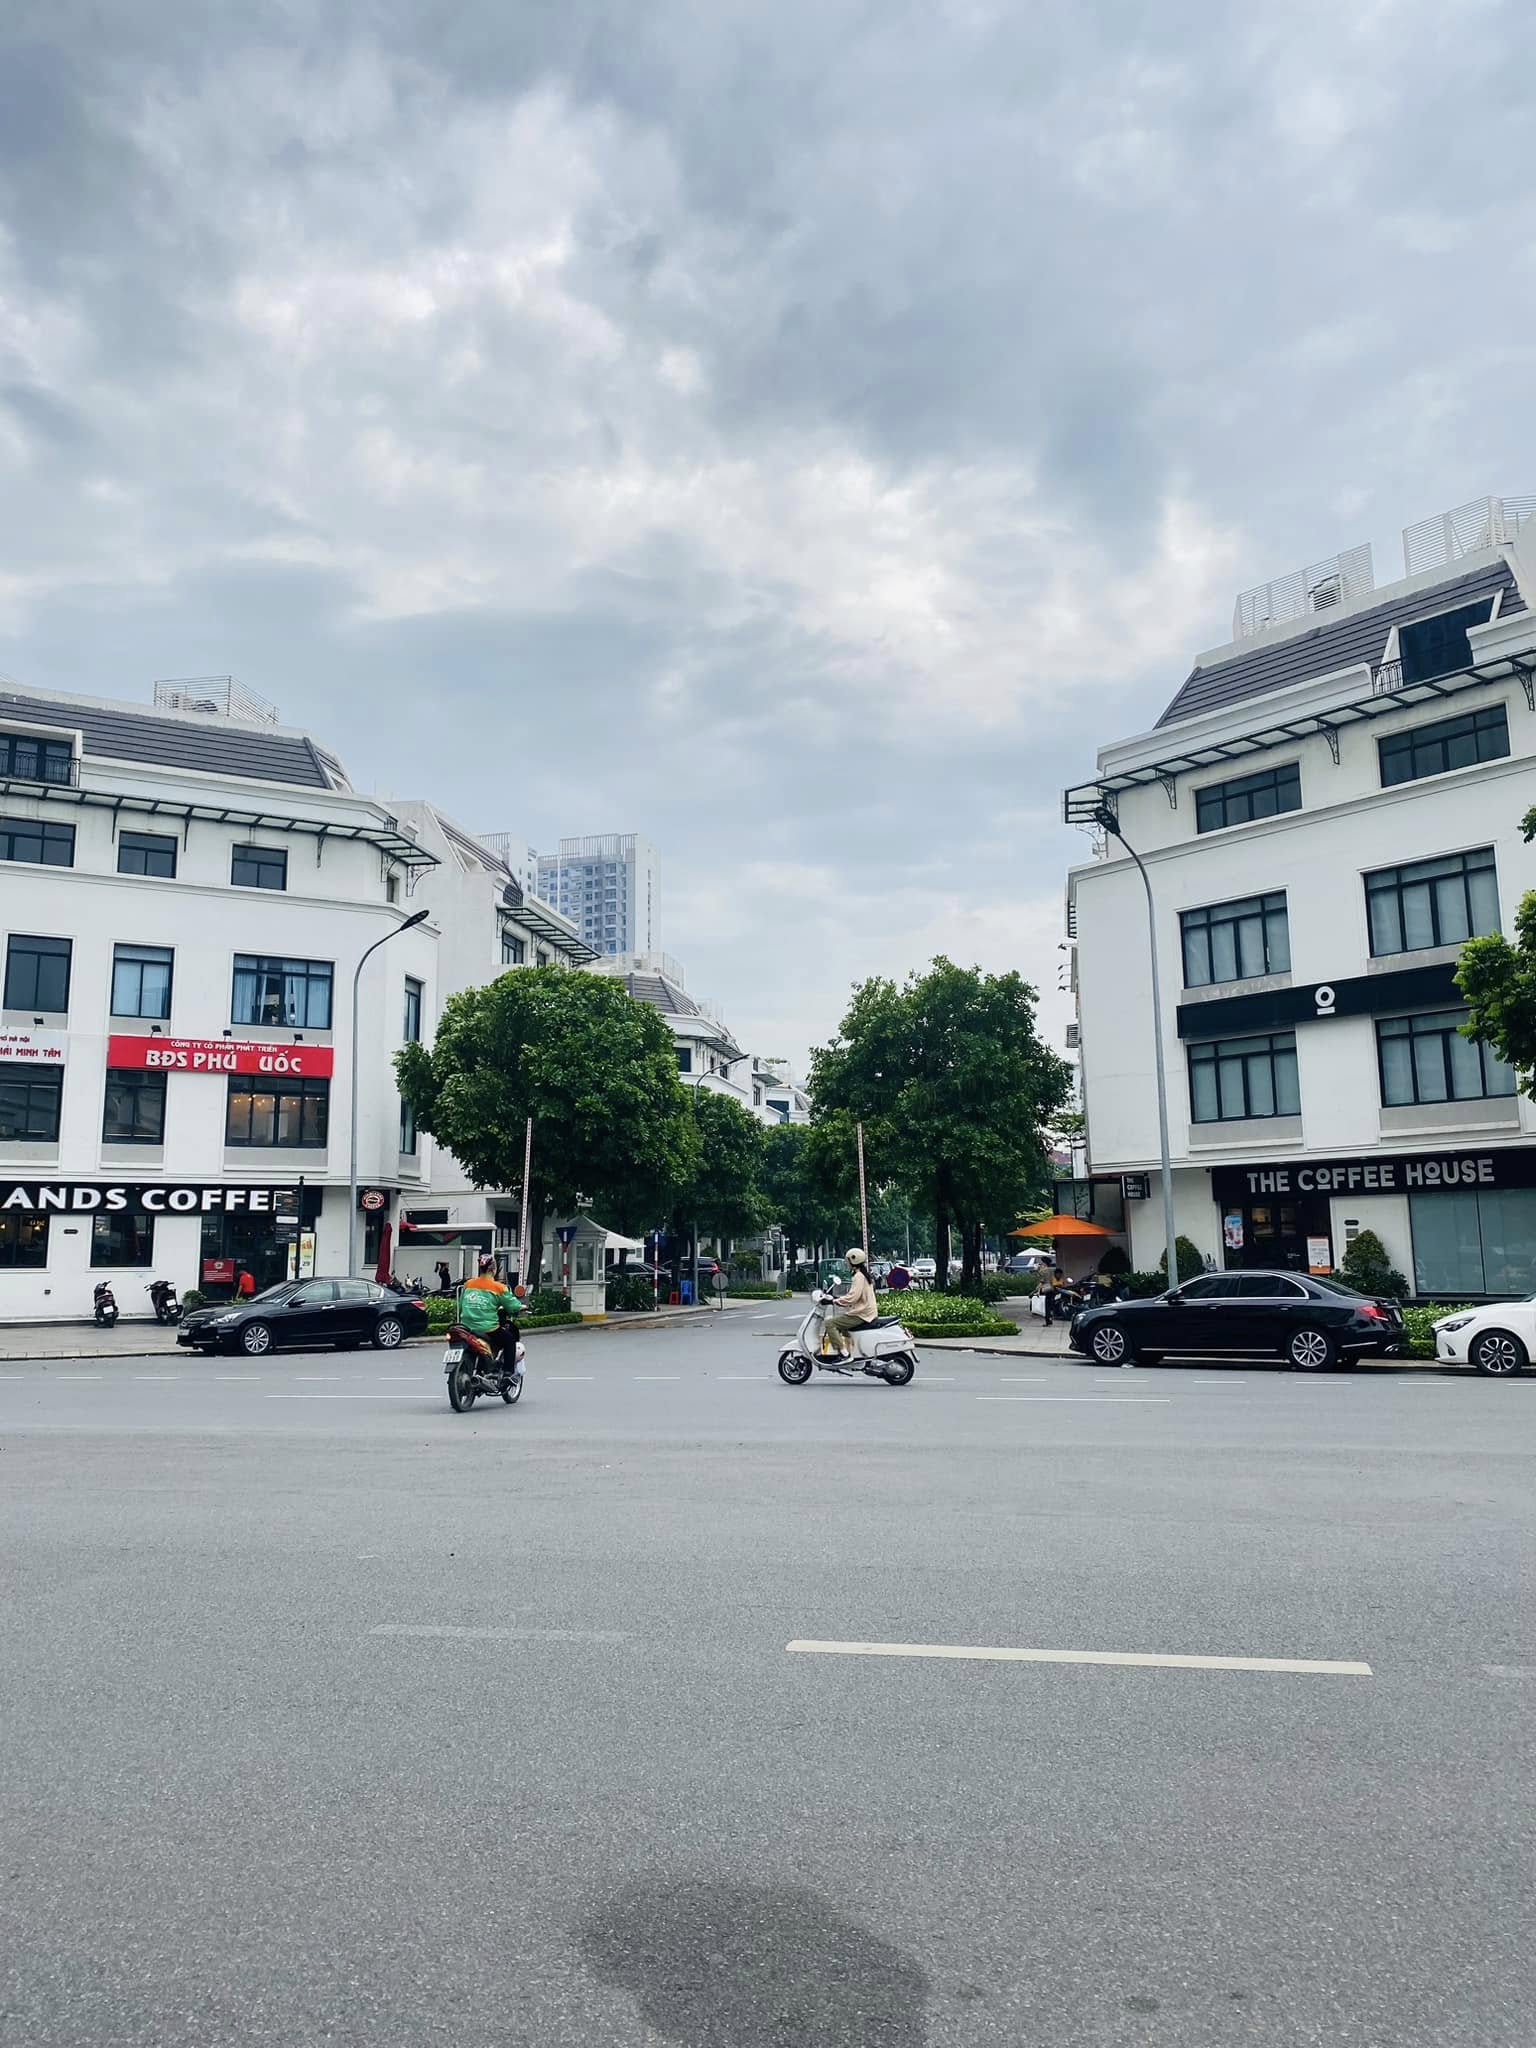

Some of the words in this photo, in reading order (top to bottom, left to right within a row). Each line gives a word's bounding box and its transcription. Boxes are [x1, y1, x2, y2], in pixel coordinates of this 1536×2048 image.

[16, 1047, 39, 1057] MINH
[43, 1047, 62, 1058] TÂM
[145, 1049, 188, 1068] BĐS
[193, 1051, 238, 1070] PHÚ
[1246, 1171, 1290, 1193] THE
[1297, 1164, 1395, 1191] COFFEE
[1405, 1158, 1495, 1187] HOUSE
